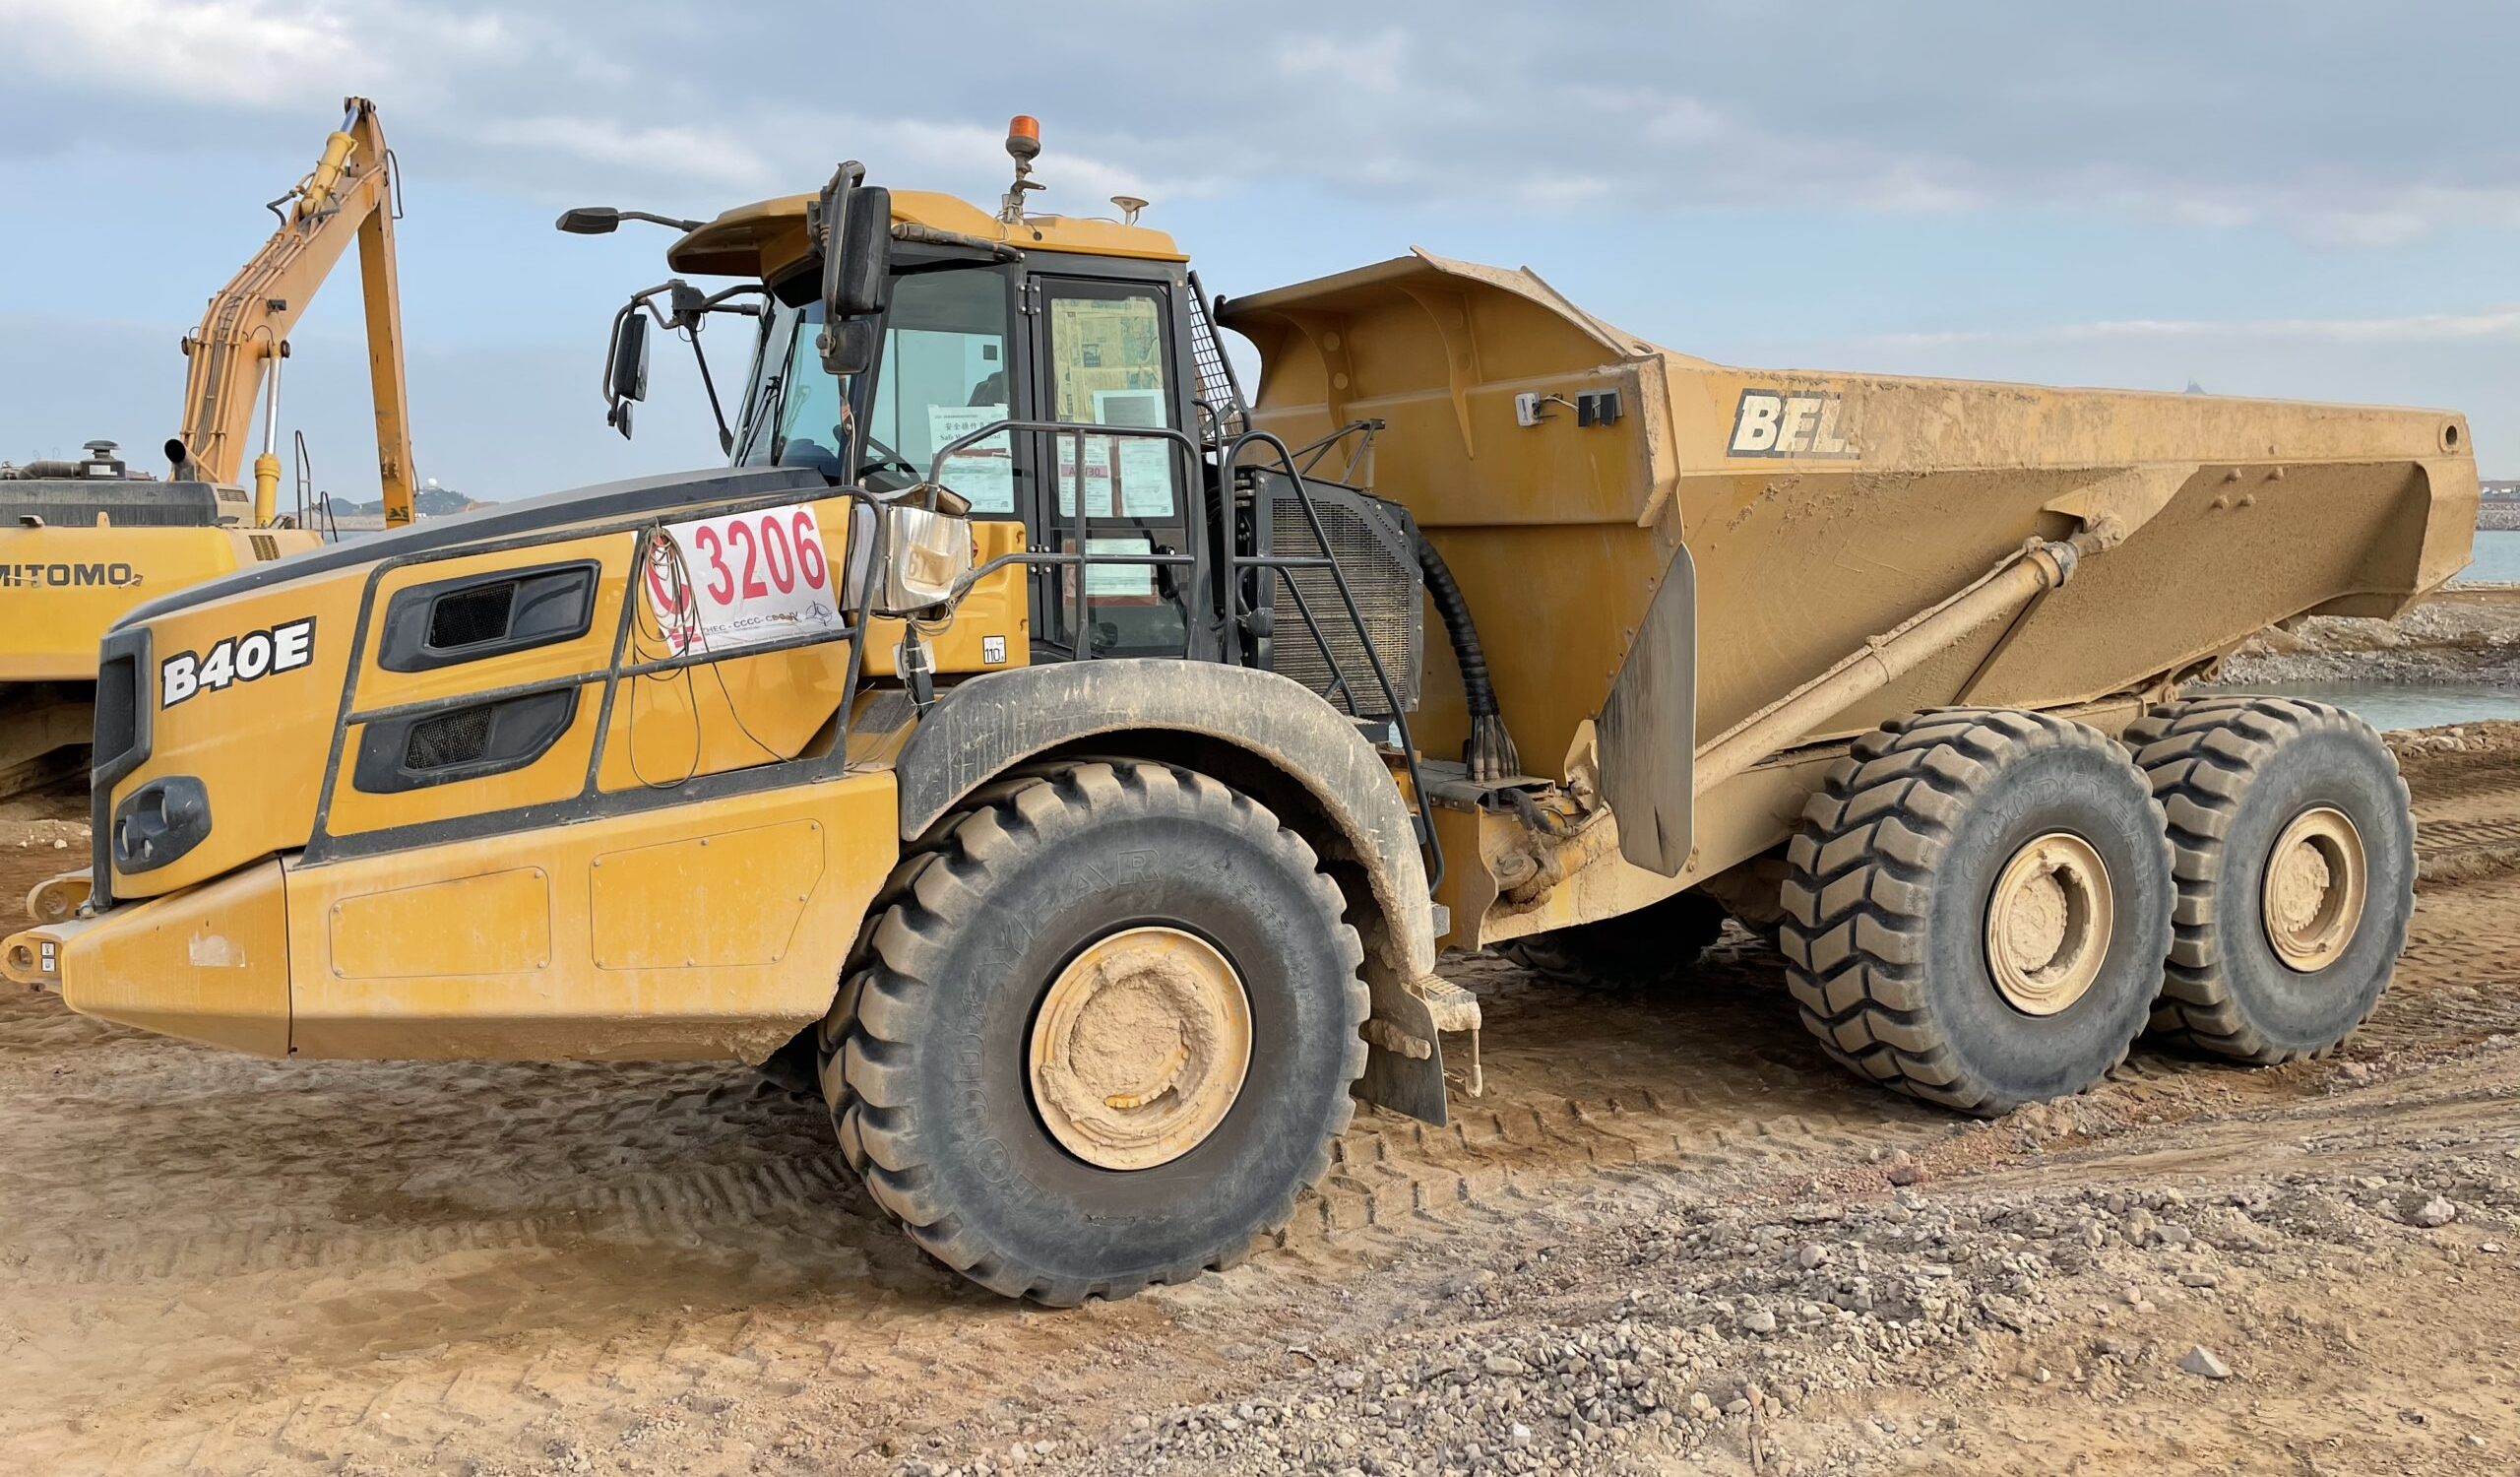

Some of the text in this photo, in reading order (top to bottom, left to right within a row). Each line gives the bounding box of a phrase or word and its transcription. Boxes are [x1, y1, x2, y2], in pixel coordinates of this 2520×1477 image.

[1731, 394, 1863, 454] BEL
[1068, 466, 1101, 477] A30
[695, 510, 826, 606] 3206
[162, 618, 315, 709] B40E
[984, 647, 1001, 663] 110
